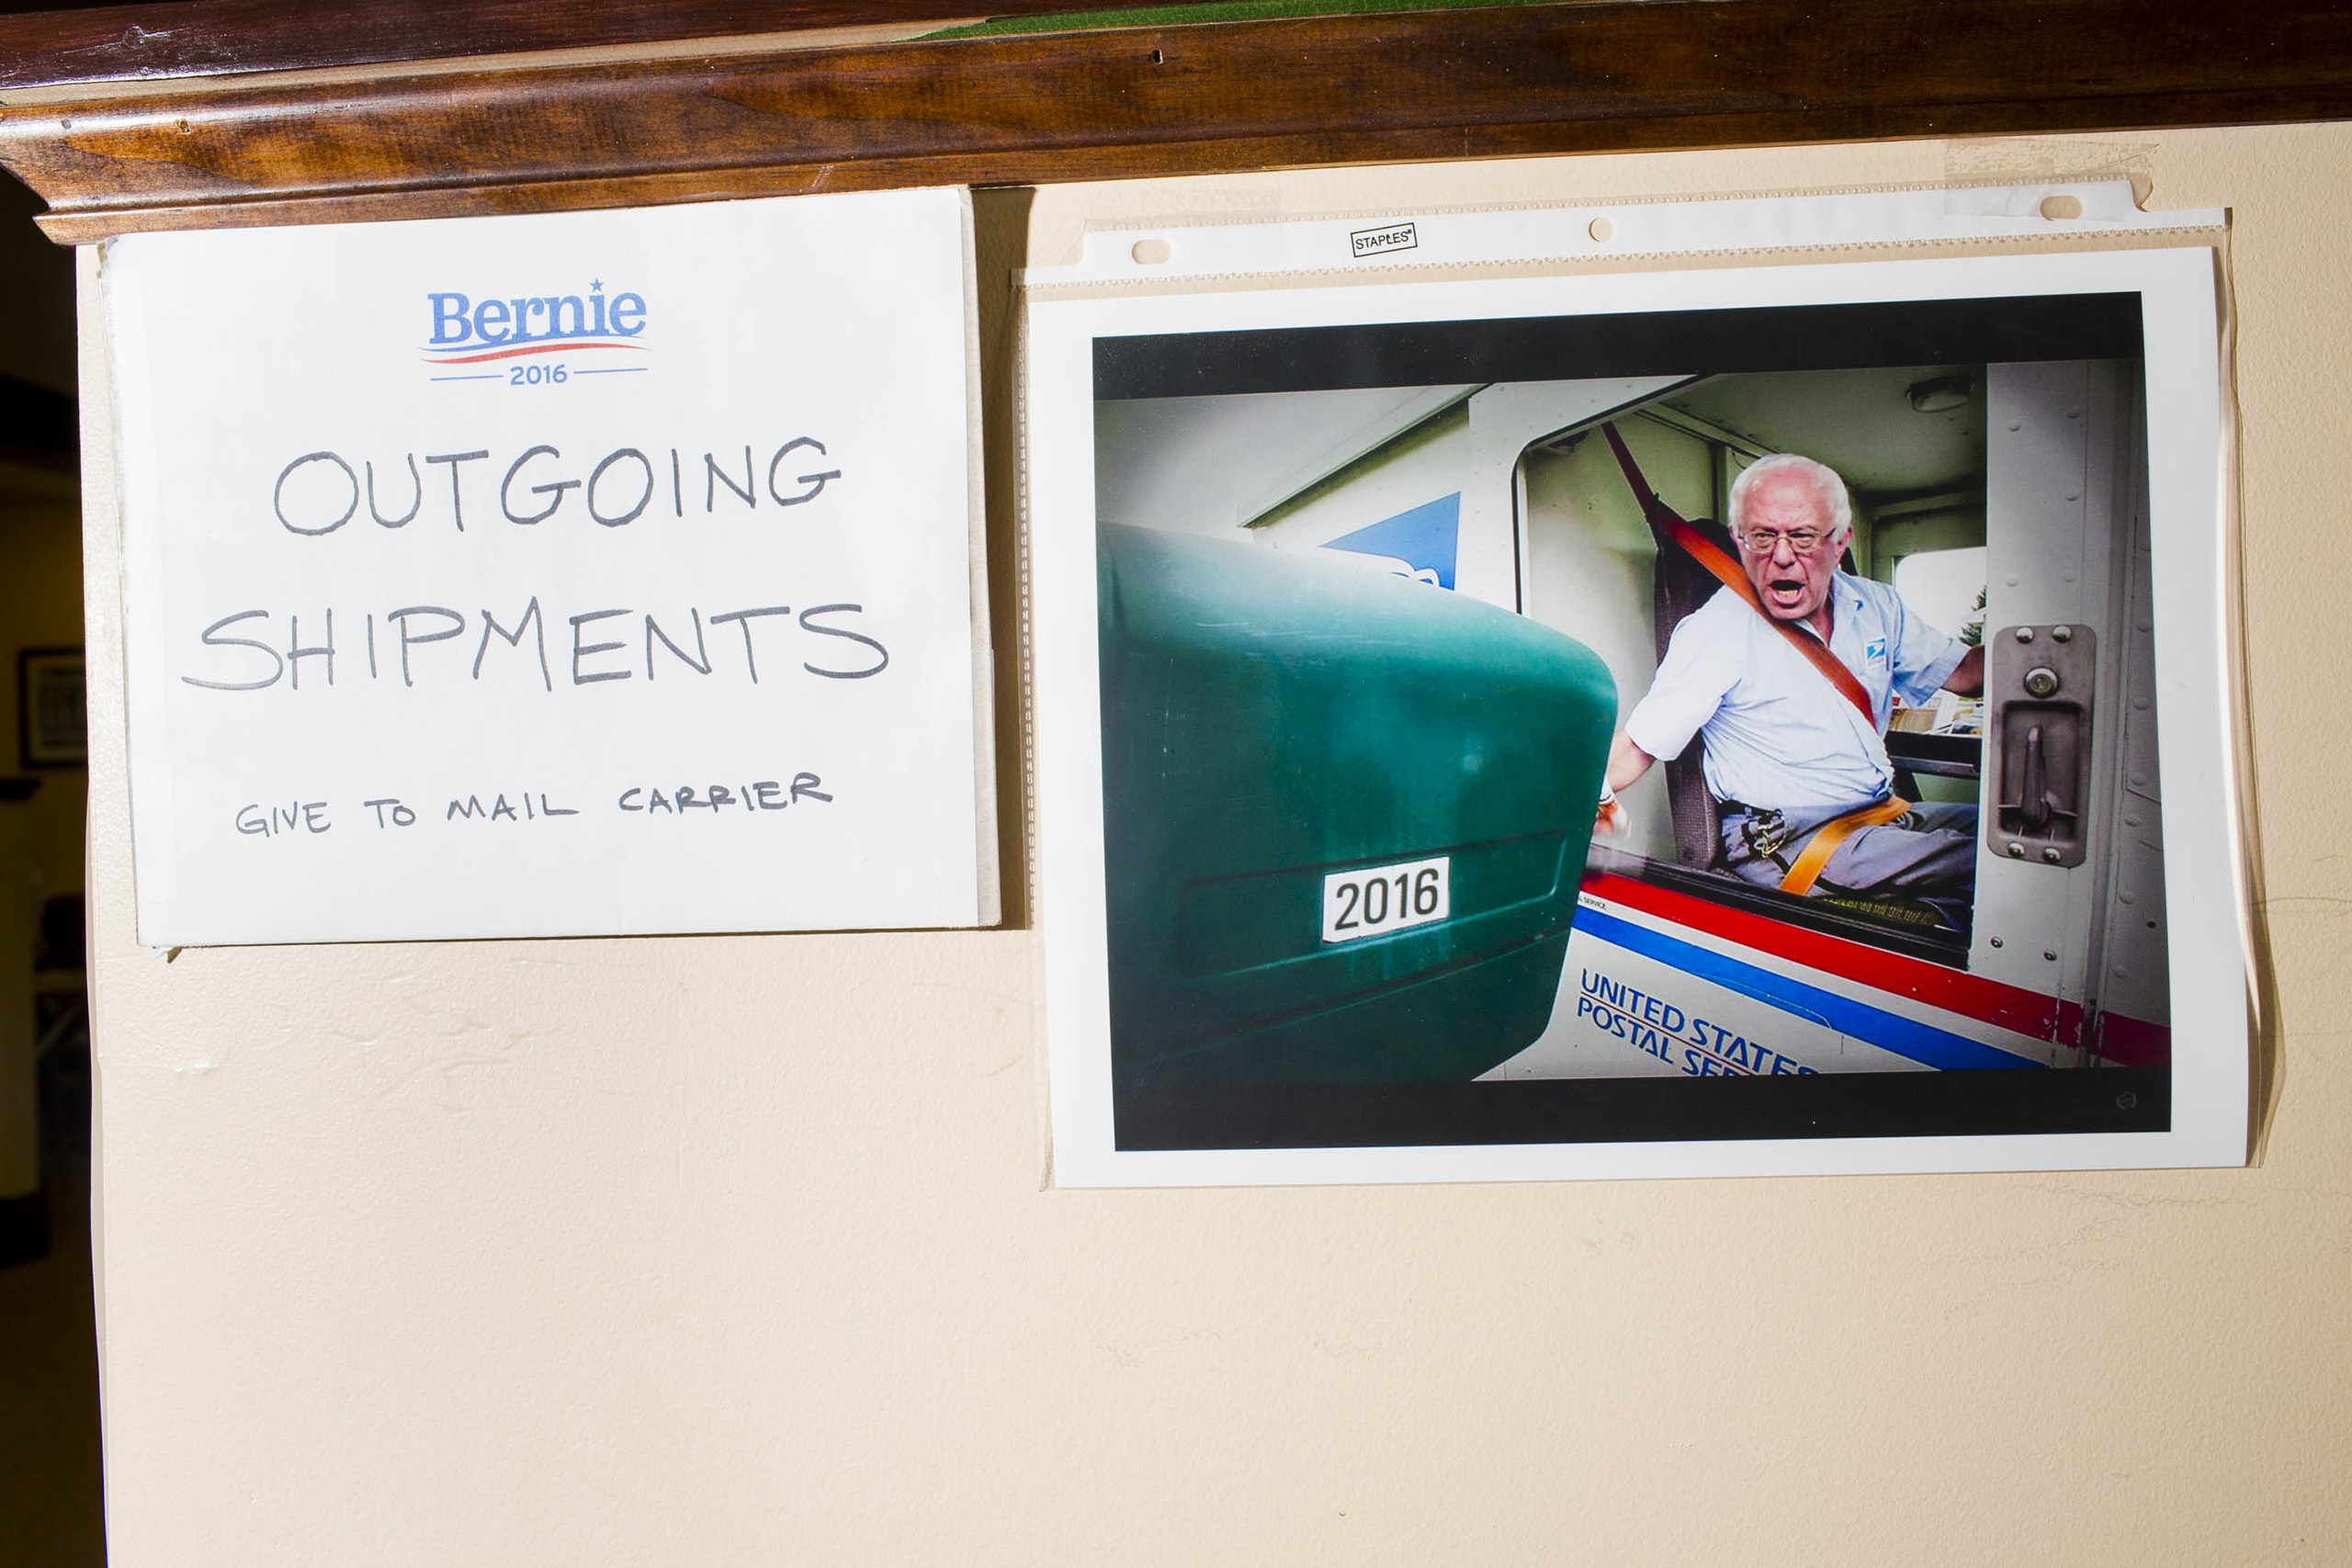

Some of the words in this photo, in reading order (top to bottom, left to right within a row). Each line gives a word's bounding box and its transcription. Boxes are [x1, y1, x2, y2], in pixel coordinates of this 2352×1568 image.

[427, 279, 648, 346] Bernie
[510, 364, 568, 386] 2016
[274, 435, 842, 536] OUTGOING
[181, 595, 889, 693] SHIPMENTS
[235, 800, 332, 838] GIVE
[363, 798, 416, 829] TO
[447, 792, 579, 821] MAIL
[618, 772, 834, 814] CARRIER
[1335, 868, 1439, 931] 2016
[1577, 996, 1673, 1065] POSTAL
[1581, 967, 1685, 1032] UNITED
